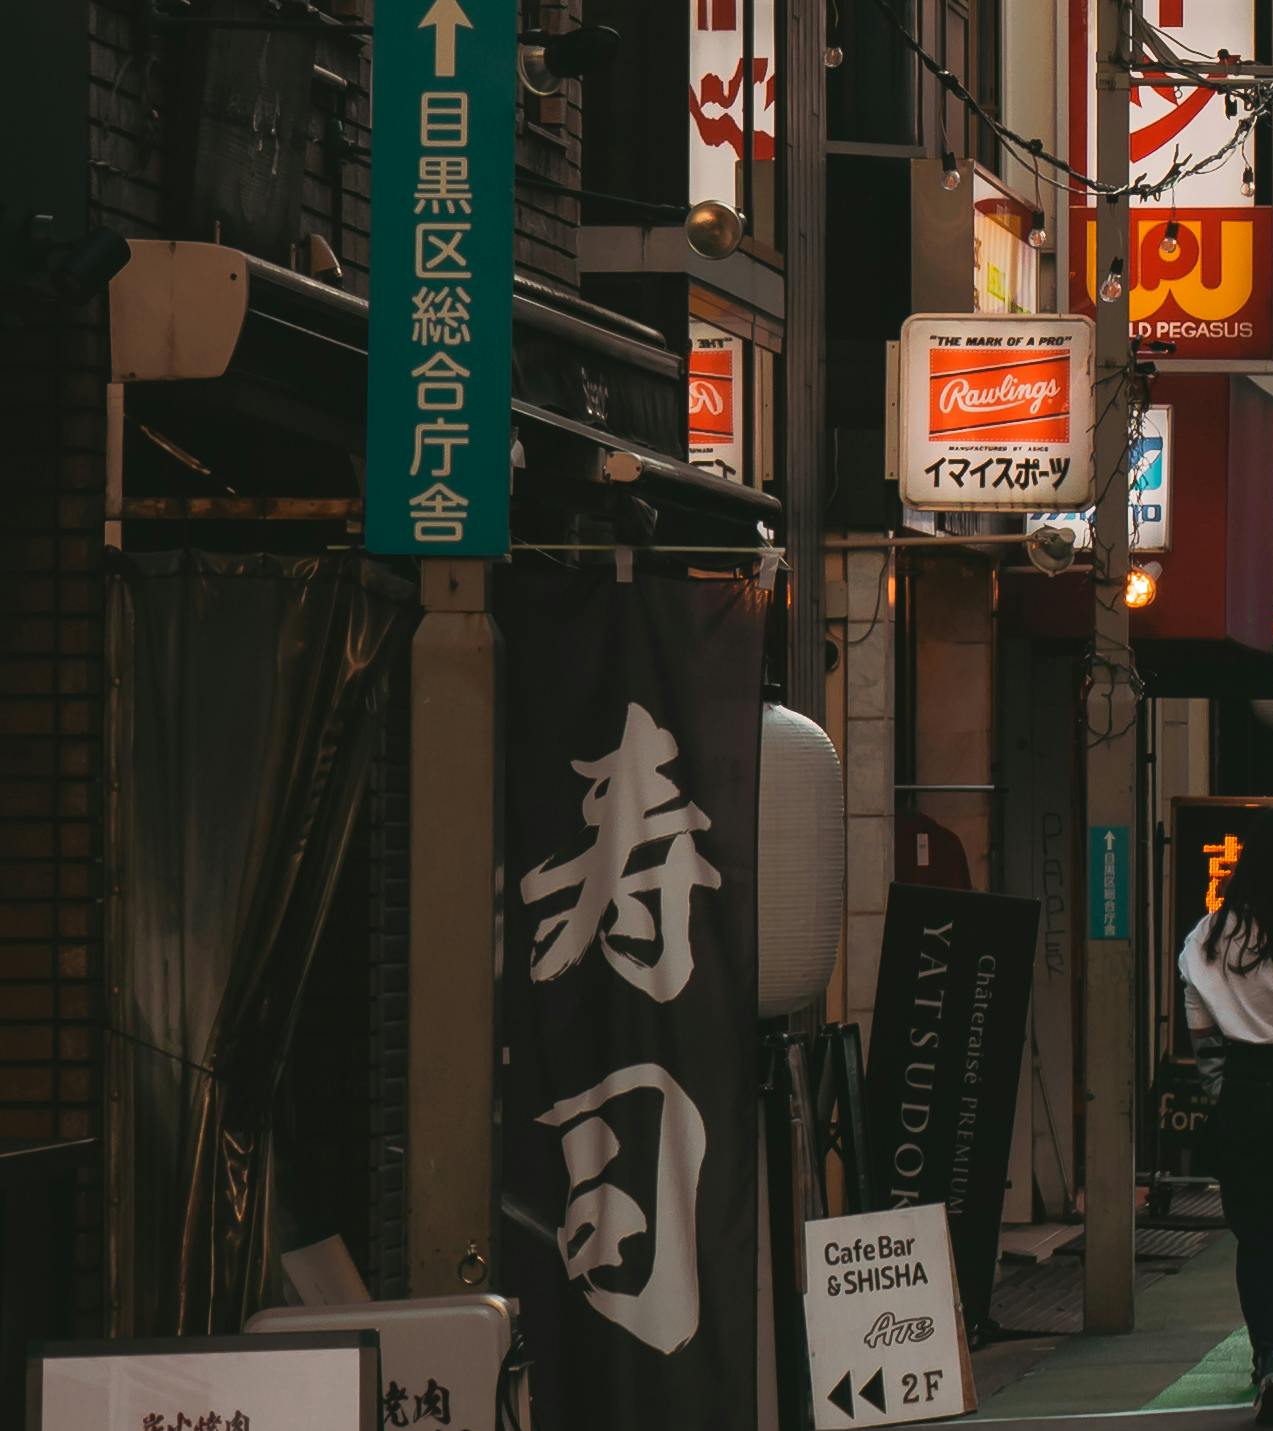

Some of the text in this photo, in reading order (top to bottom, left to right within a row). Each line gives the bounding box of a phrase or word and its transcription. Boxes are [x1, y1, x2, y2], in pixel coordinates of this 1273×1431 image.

[412, 90, 474, 543] 目黒区総合庁舎
[1156, 321, 1253, 339] PEGASUS
[965, 336, 1002, 348] MARK
[1006, 336, 1024, 348] OF
[1025, 336, 1037, 348] A
[939, 374, 1061, 415] Rawlings
[923, 457, 1072, 491] イマイスポーツ
[519, 701, 723, 1355] 寿司
[824, 1235, 916, 1266] Cafe Bar
[827, 1261, 929, 1297] & SHISHA
[901, 1368, 944, 1405] 2F
